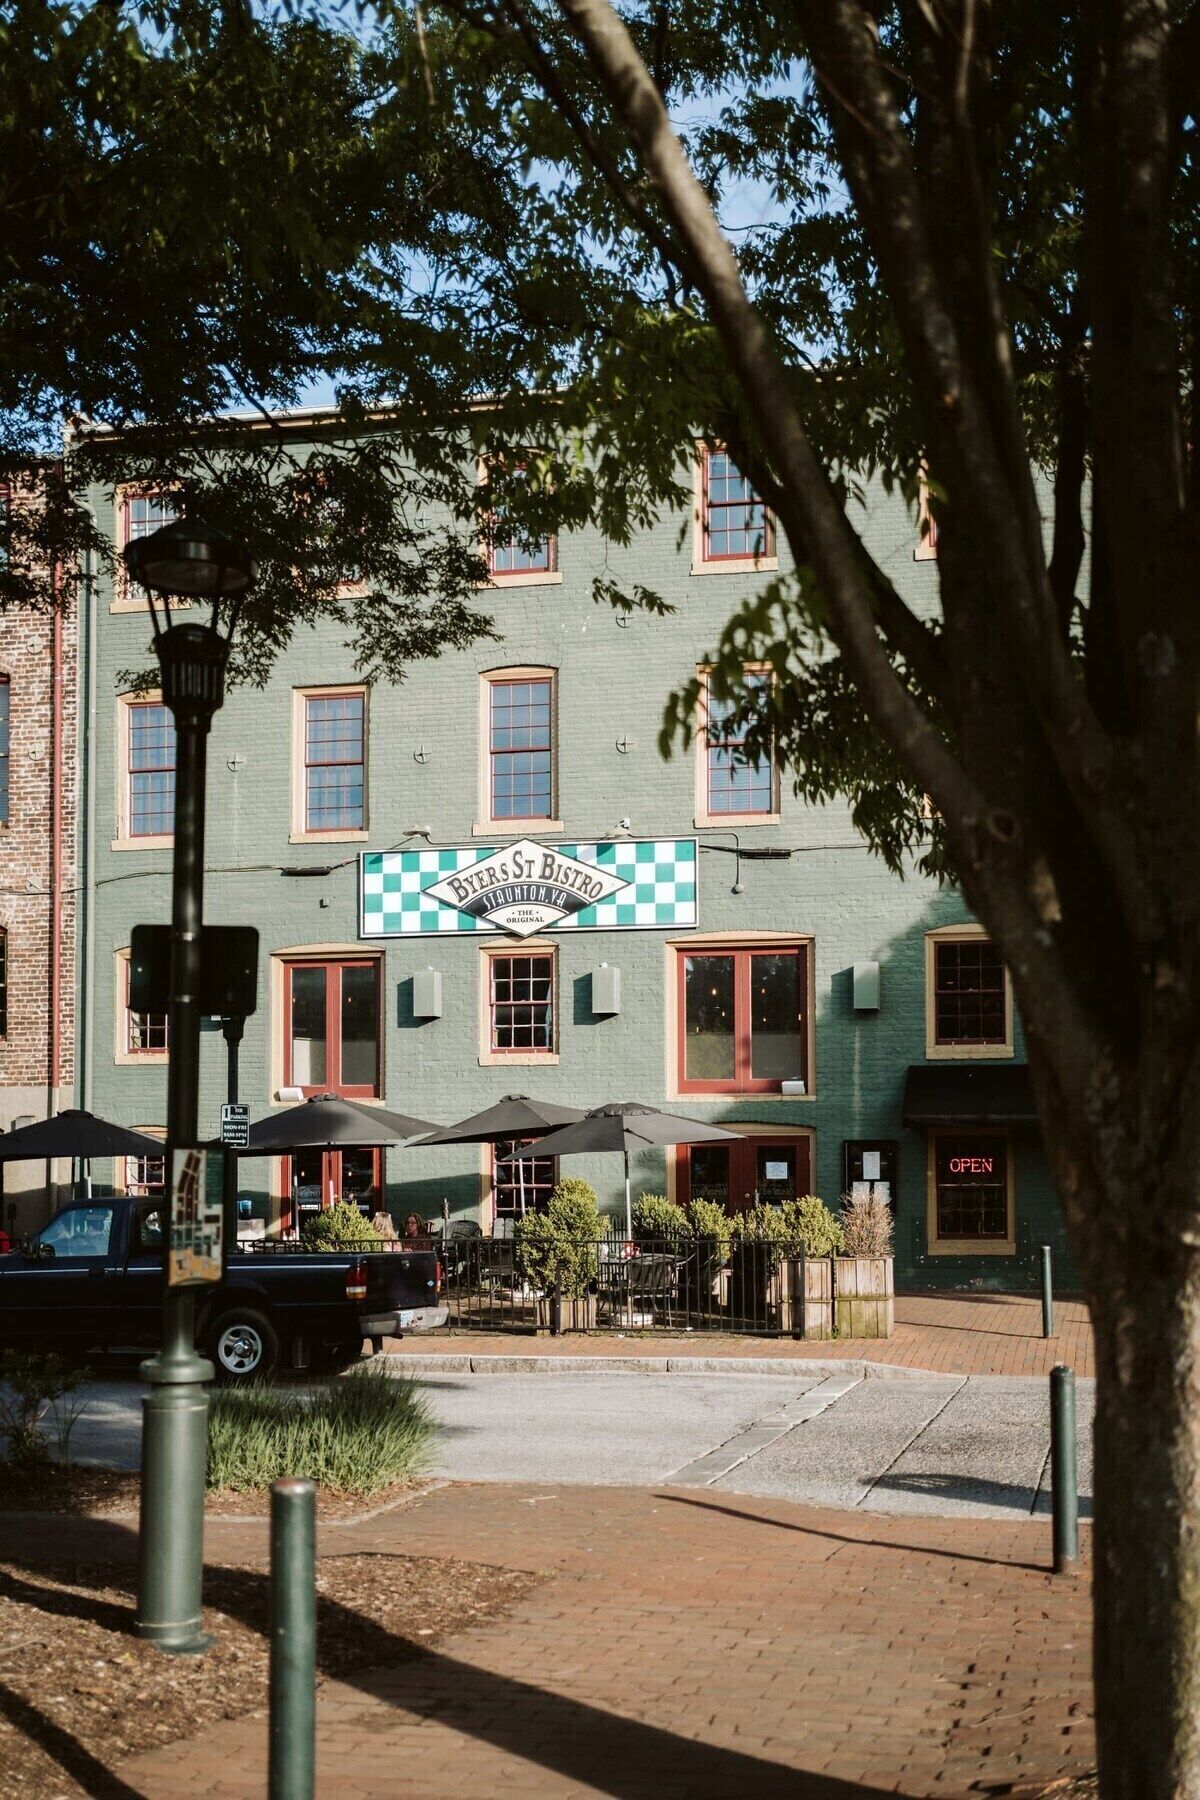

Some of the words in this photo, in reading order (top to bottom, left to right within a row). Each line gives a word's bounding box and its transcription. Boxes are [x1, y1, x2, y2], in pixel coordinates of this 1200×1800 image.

[447, 863, 509, 903] BYERS
[512, 850, 535, 879] ST
[538, 852, 604, 899] BISTRO
[506, 916, 545, 924] ORIGINAL
[949, 1157, 994, 1173] OPEN
